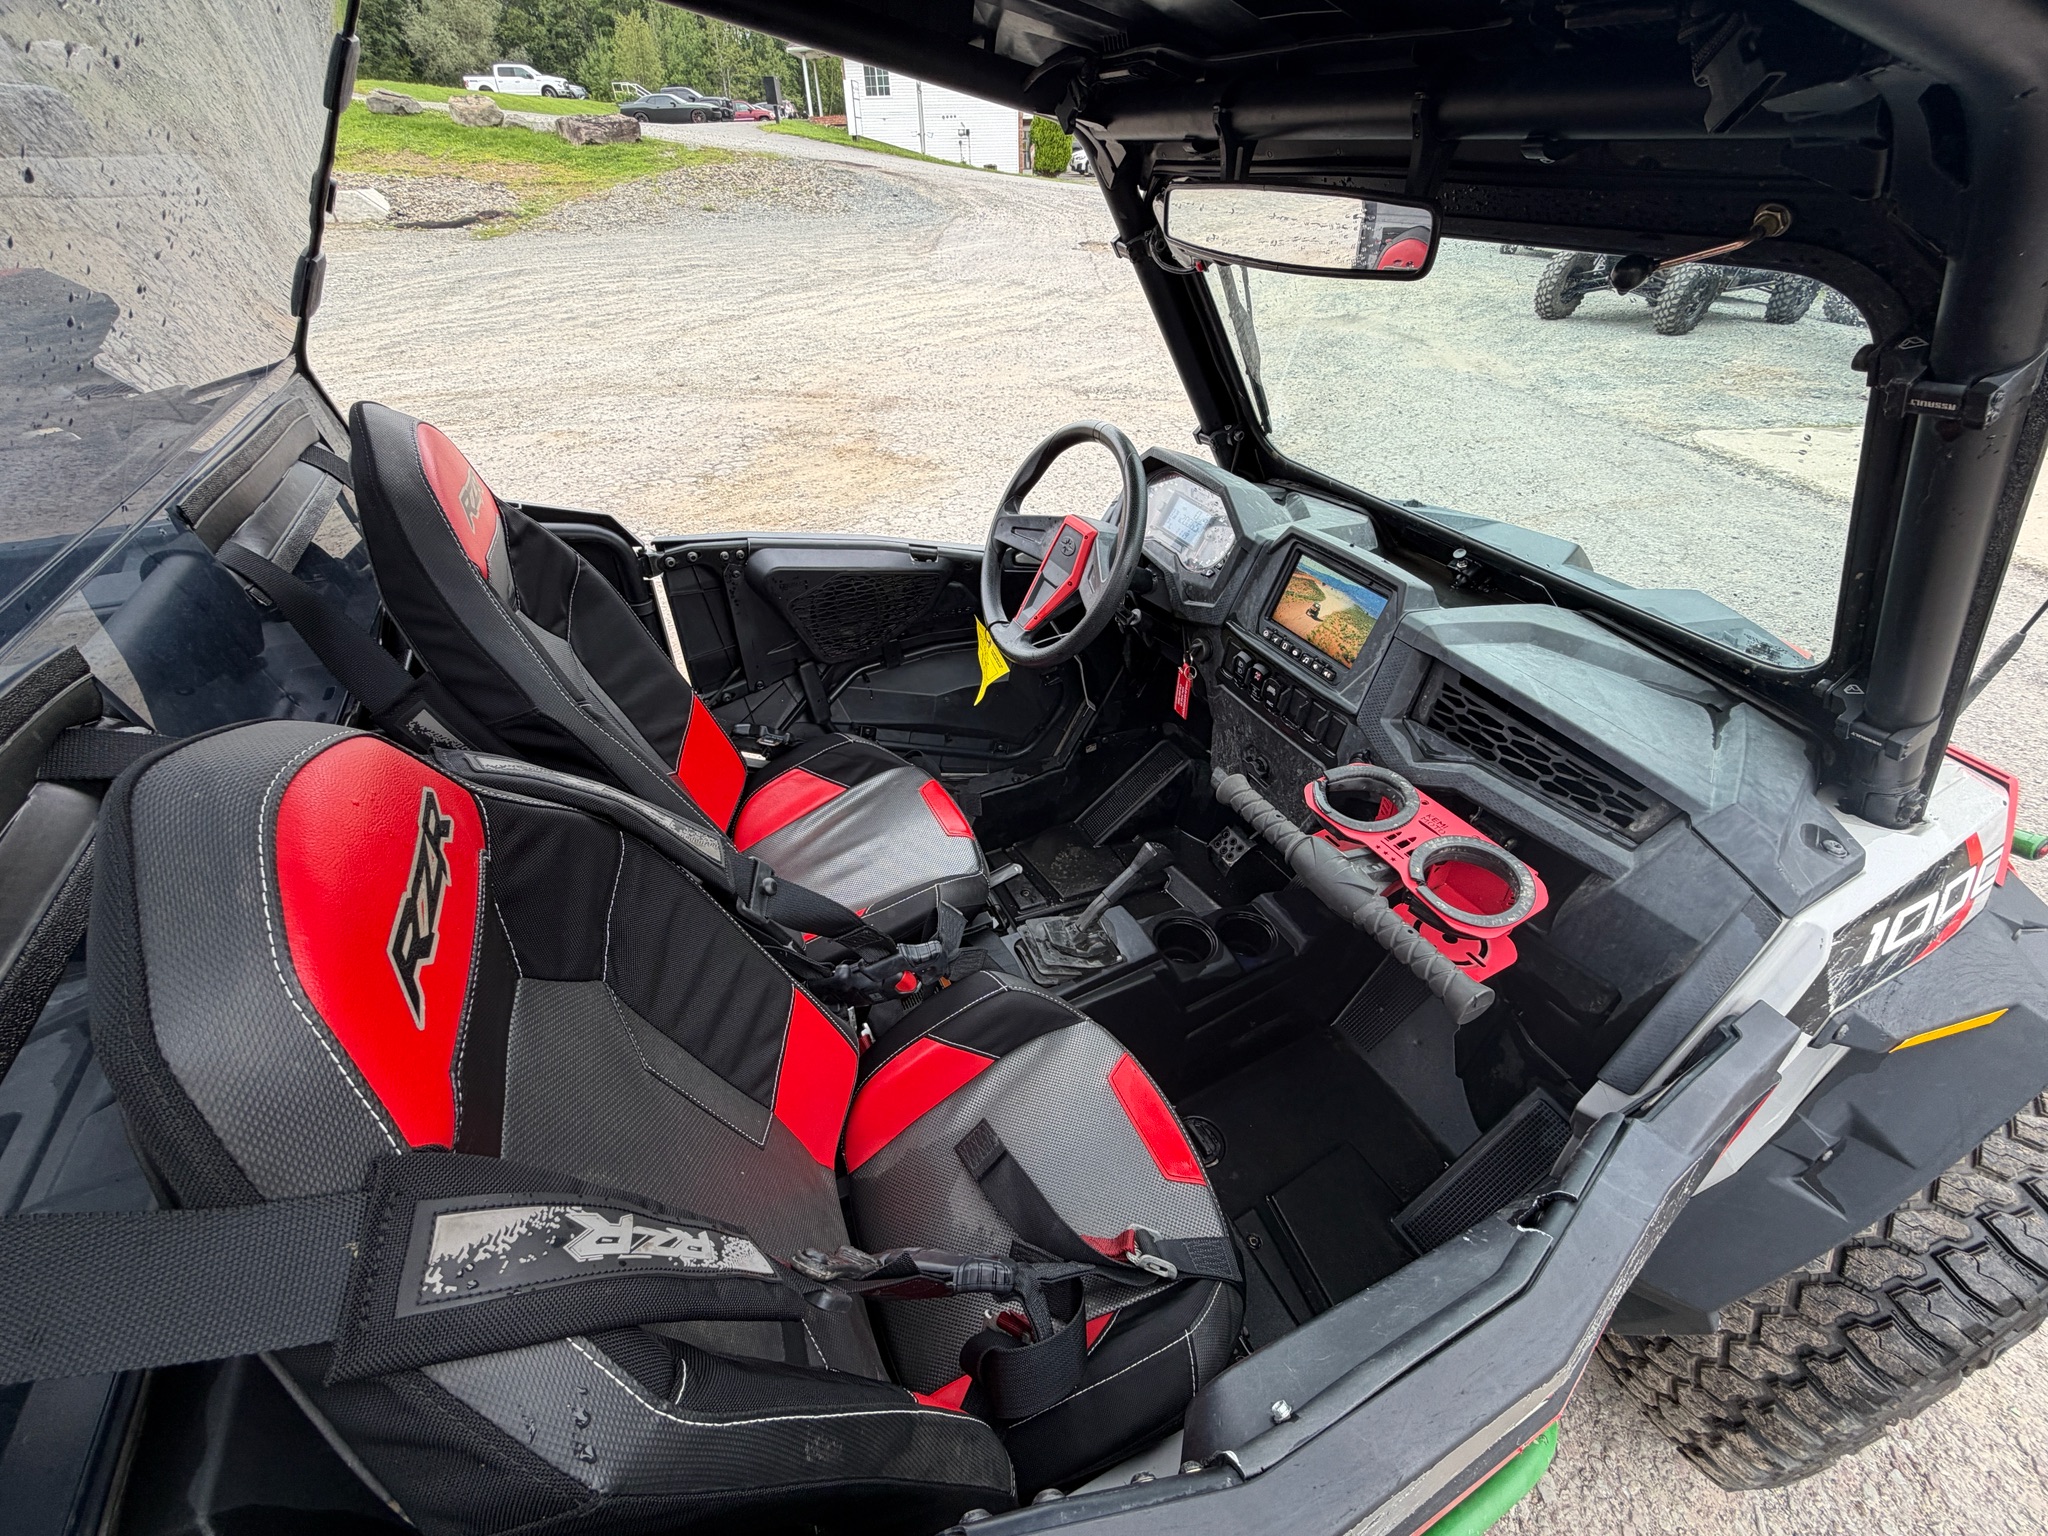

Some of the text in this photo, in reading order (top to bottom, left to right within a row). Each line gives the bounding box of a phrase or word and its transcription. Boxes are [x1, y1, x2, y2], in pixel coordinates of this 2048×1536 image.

[1909, 398, 1957, 411] ASSAULT
[1420, 816, 1446, 835] MOTO
[1426, 813, 1449, 830] KEMI
[386, 786, 454, 1030] RZR
[562, 1212, 712, 1263] RZR
